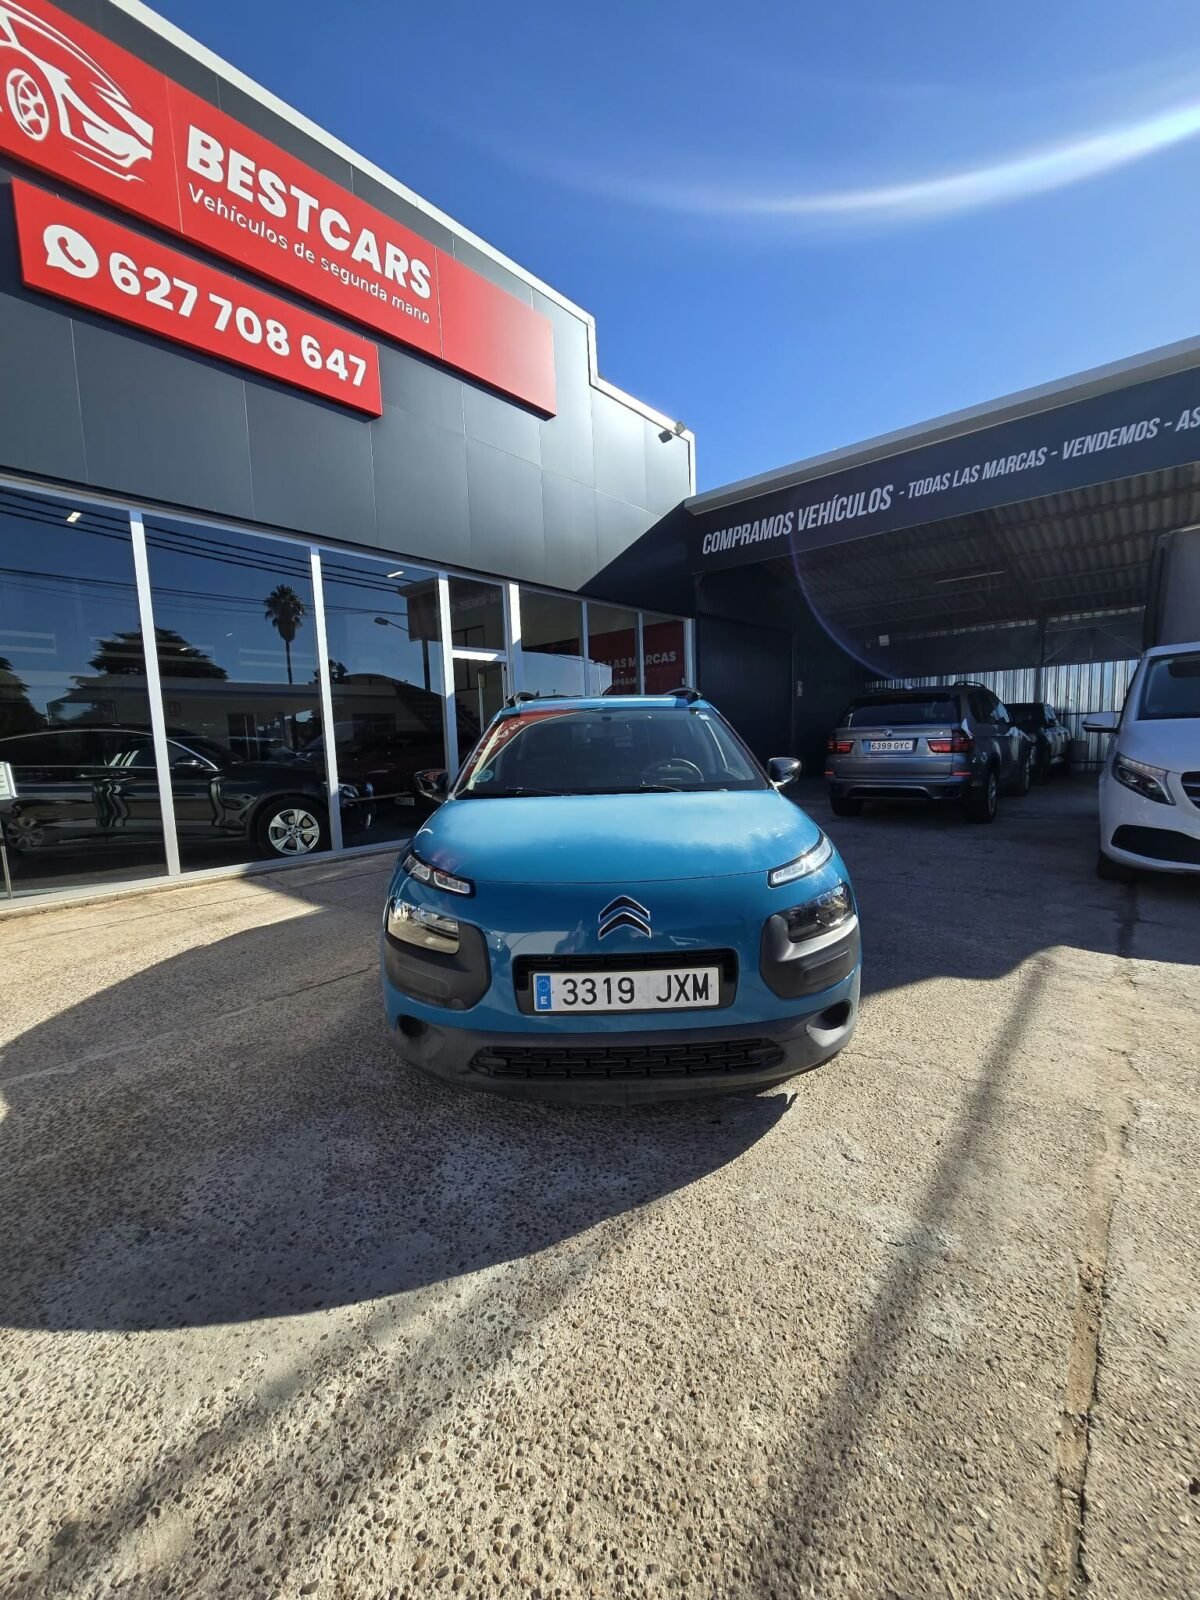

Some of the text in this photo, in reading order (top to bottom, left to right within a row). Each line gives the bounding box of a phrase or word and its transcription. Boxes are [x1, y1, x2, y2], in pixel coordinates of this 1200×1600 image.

[187, 124, 431, 299] BESTCARS
[188, 182, 430, 324] Vehículos de segunda mano
[109, 252, 367, 386] 627 708 647
[702, 511, 794, 555] COMPRAMOS
[798, 485, 893, 531] VEHÍCULOS
[908, 473, 951, 499] TODAS
[952, 465, 980, 488] LAS
[982, 447, 1048, 480] MARCAS
[1062, 417, 1160, 460] VENDEMOS
[871, 742, 892, 750] 6399
[541, 973, 709, 1006] E 3319 JXM
